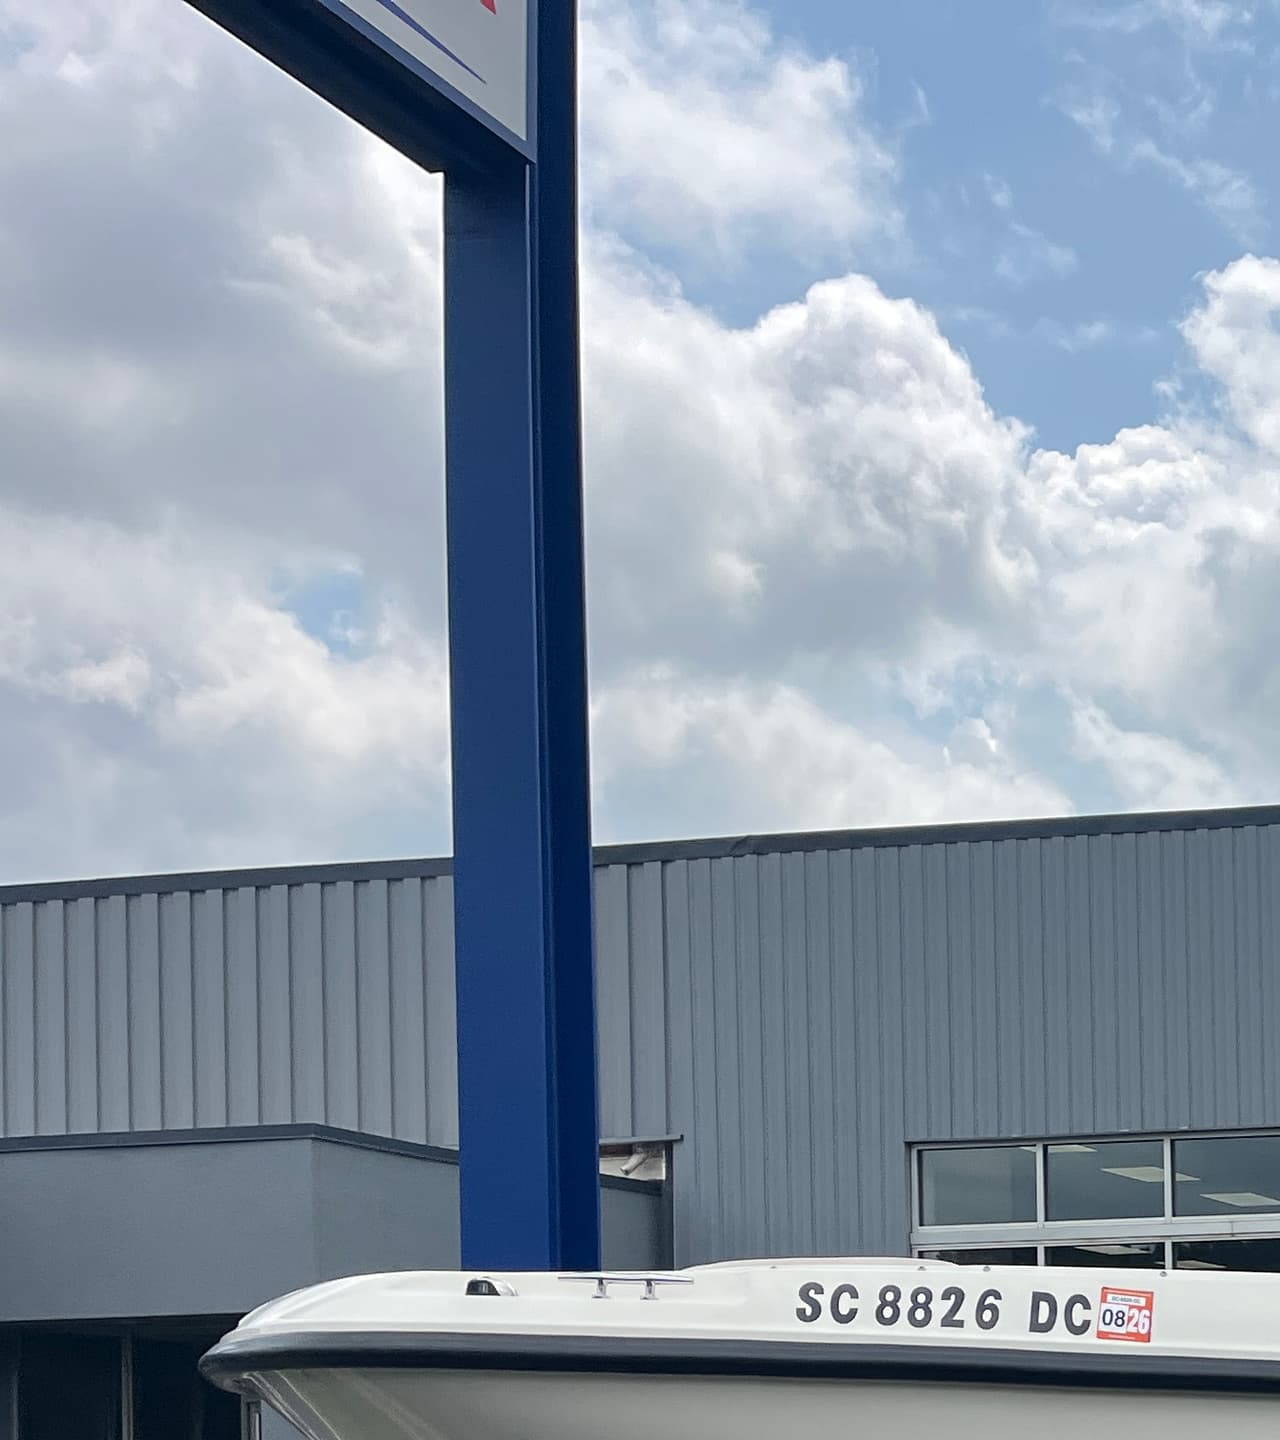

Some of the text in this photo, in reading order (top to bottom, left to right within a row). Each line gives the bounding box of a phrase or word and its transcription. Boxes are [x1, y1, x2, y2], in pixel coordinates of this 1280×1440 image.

[795, 1281, 1093, 1337] SC 8826 DC
[1102, 1307, 1151, 1335] 08 26
